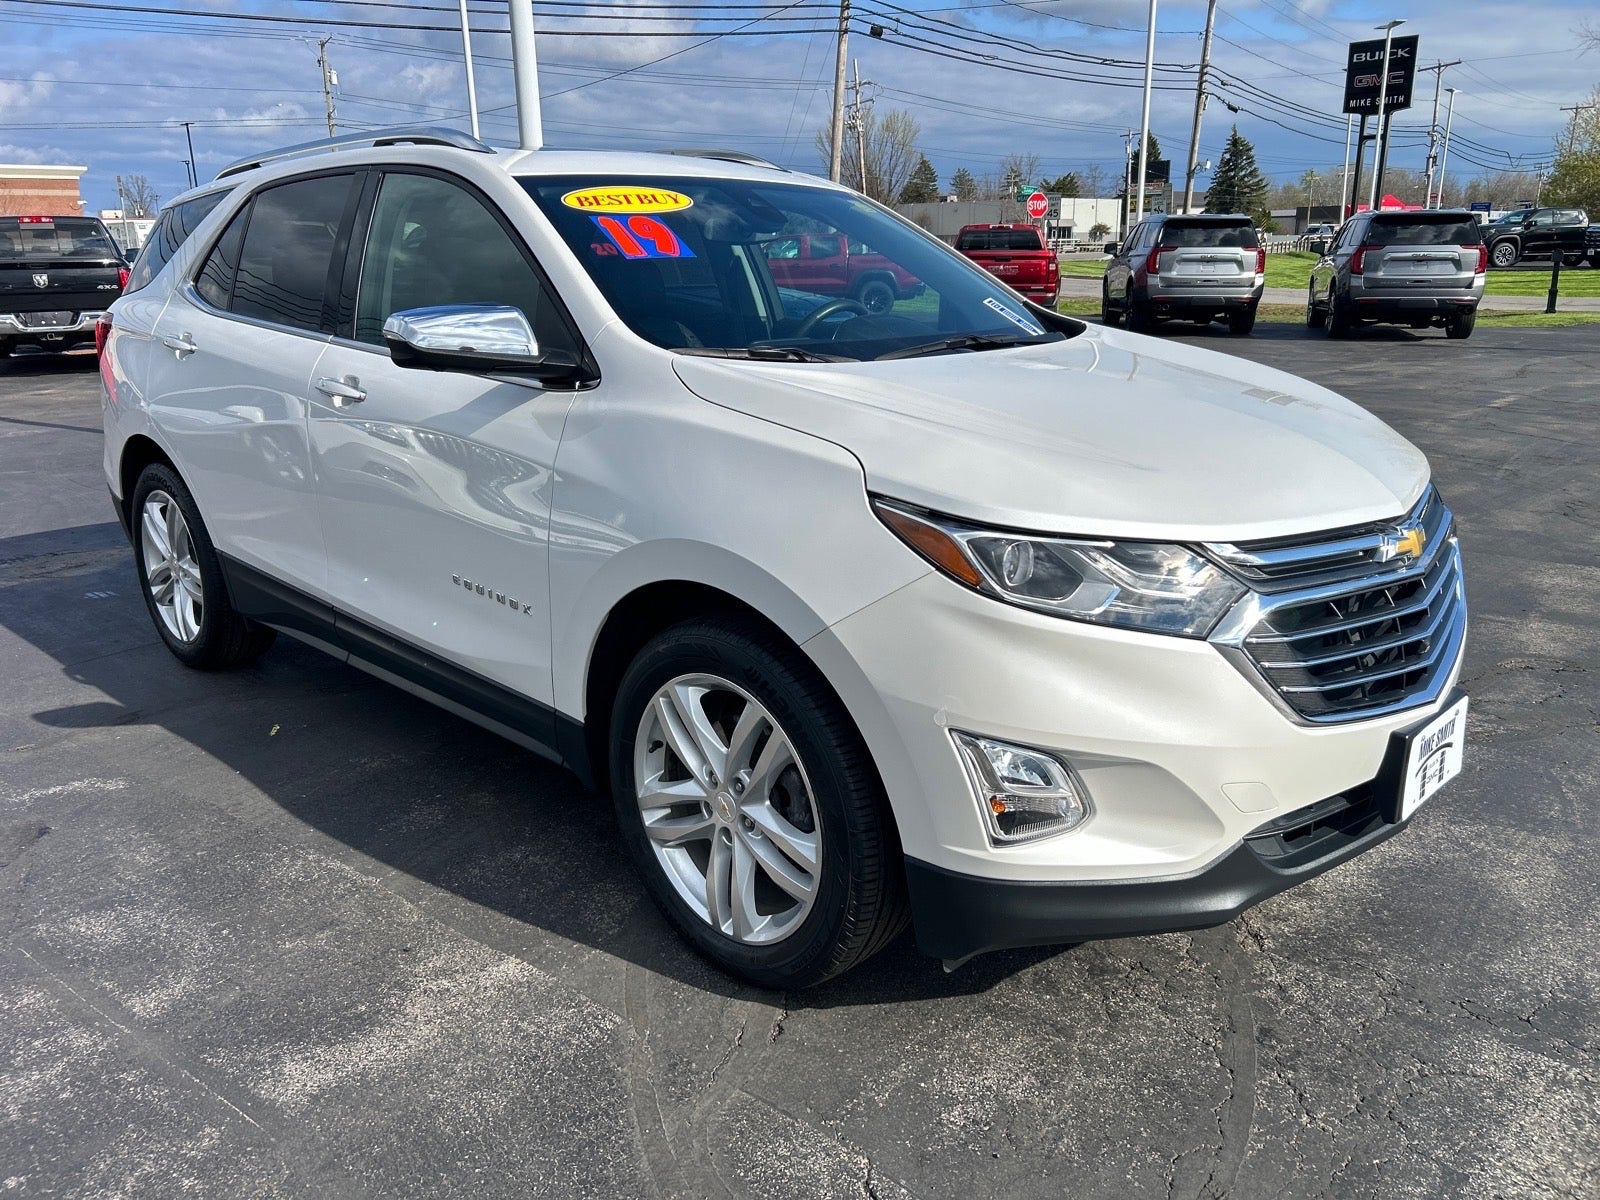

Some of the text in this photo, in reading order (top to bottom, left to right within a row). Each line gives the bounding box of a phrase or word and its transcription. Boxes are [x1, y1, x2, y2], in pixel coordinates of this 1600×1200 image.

[1353, 47, 1411, 62] BUICK
[1354, 71, 1405, 87] GMC
[1349, 98, 1371, 107] MIKE
[576, 194, 682, 207] BEST BUY
[1028, 200, 1047, 210] STOP
[1047, 209, 1059, 218] 45
[597, 216, 681, 257] 19
[452, 573, 532, 616] EQUINOX
[1418, 717, 1457, 762] MIKE SMITH
